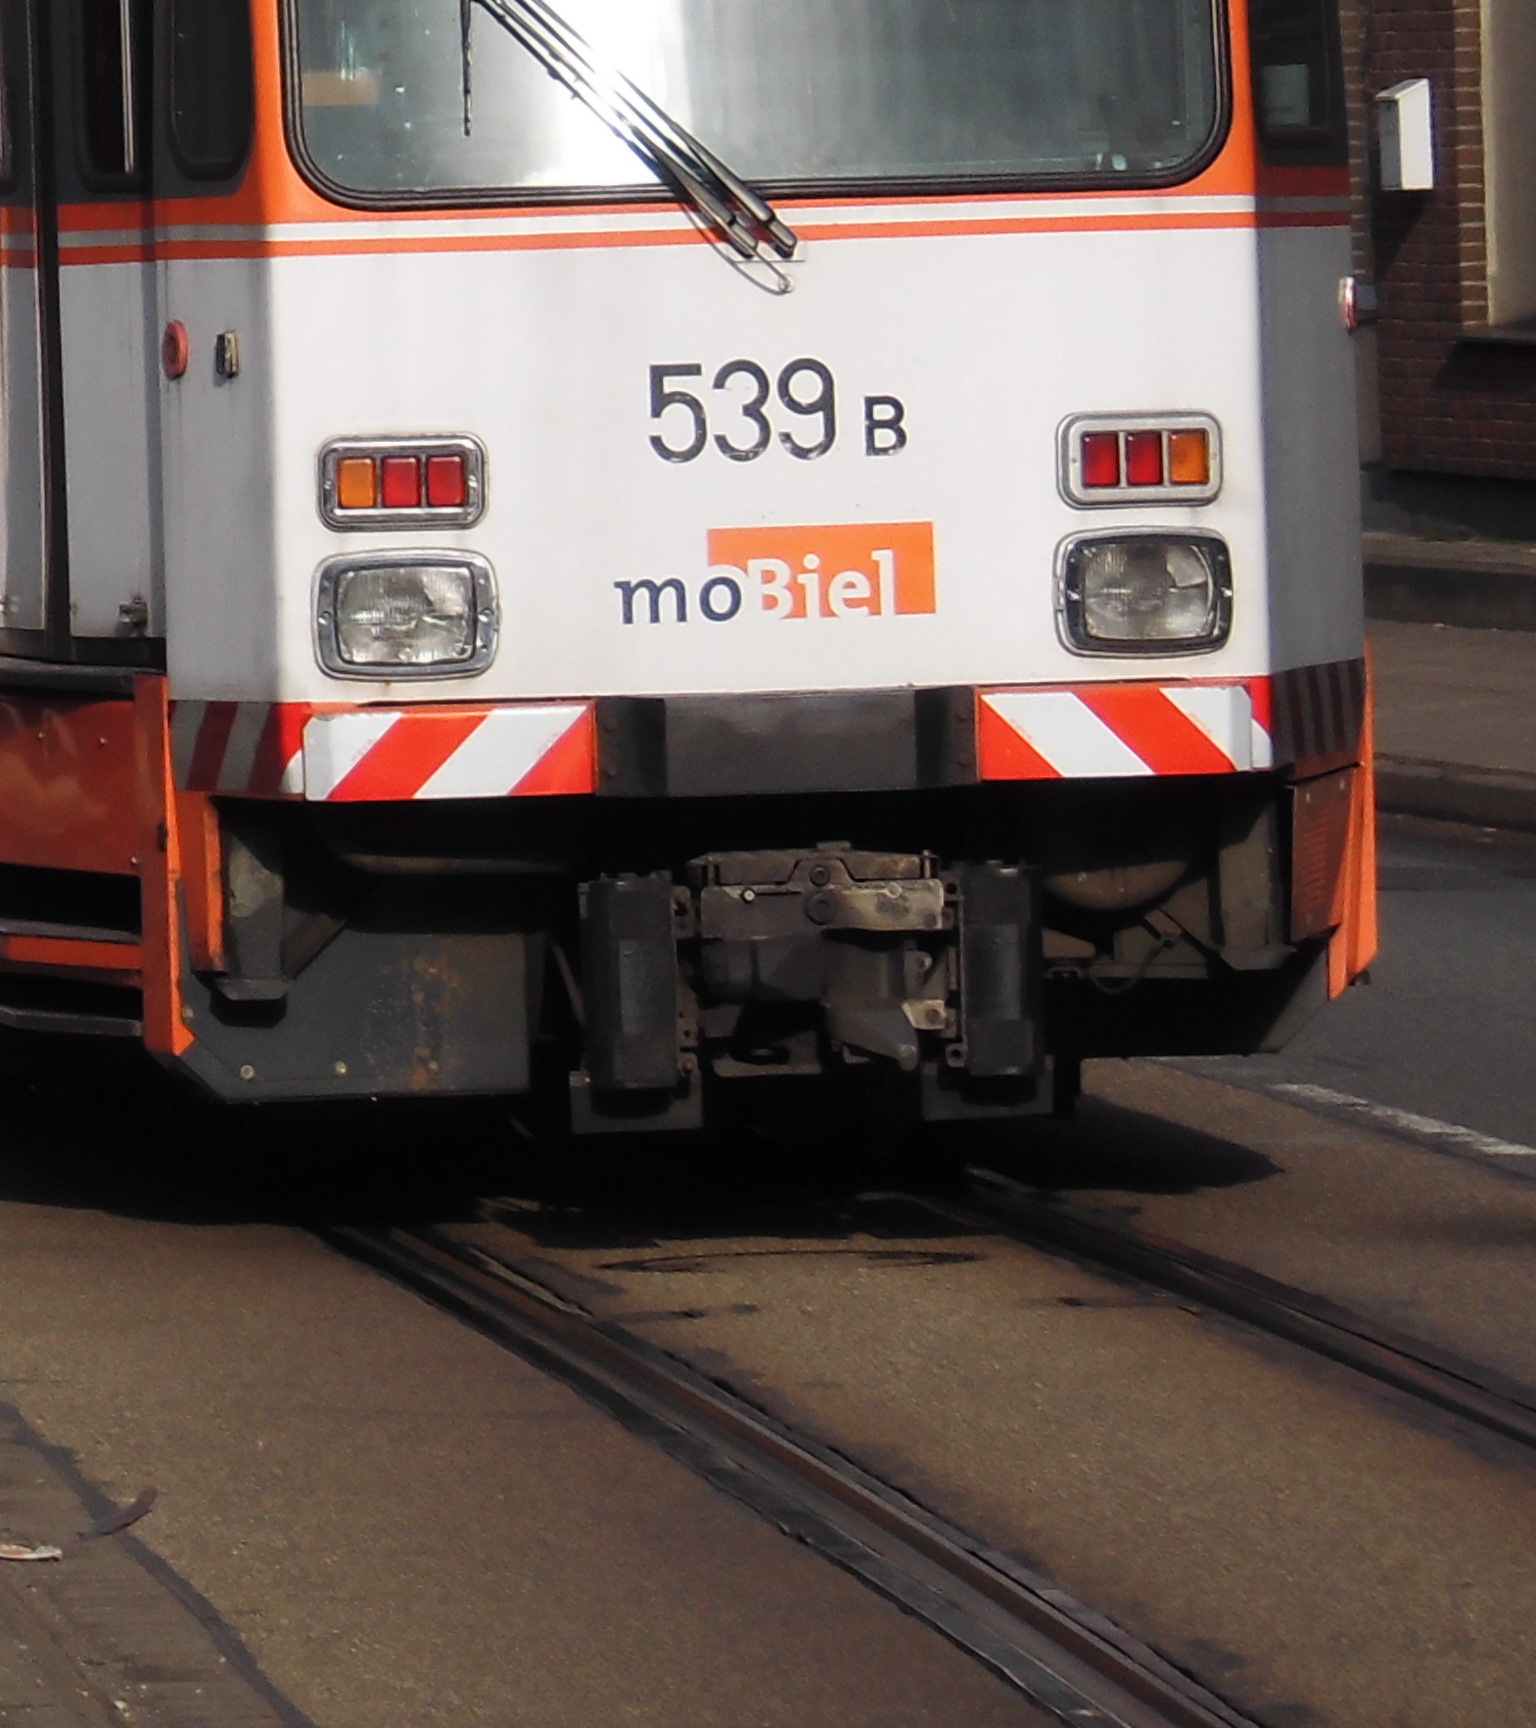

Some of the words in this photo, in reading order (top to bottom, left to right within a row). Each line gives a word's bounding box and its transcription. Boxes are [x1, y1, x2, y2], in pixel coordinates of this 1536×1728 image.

[647, 357, 838, 464] 539
[863, 394, 908, 457] B
[613, 547, 897, 625] moBiel
